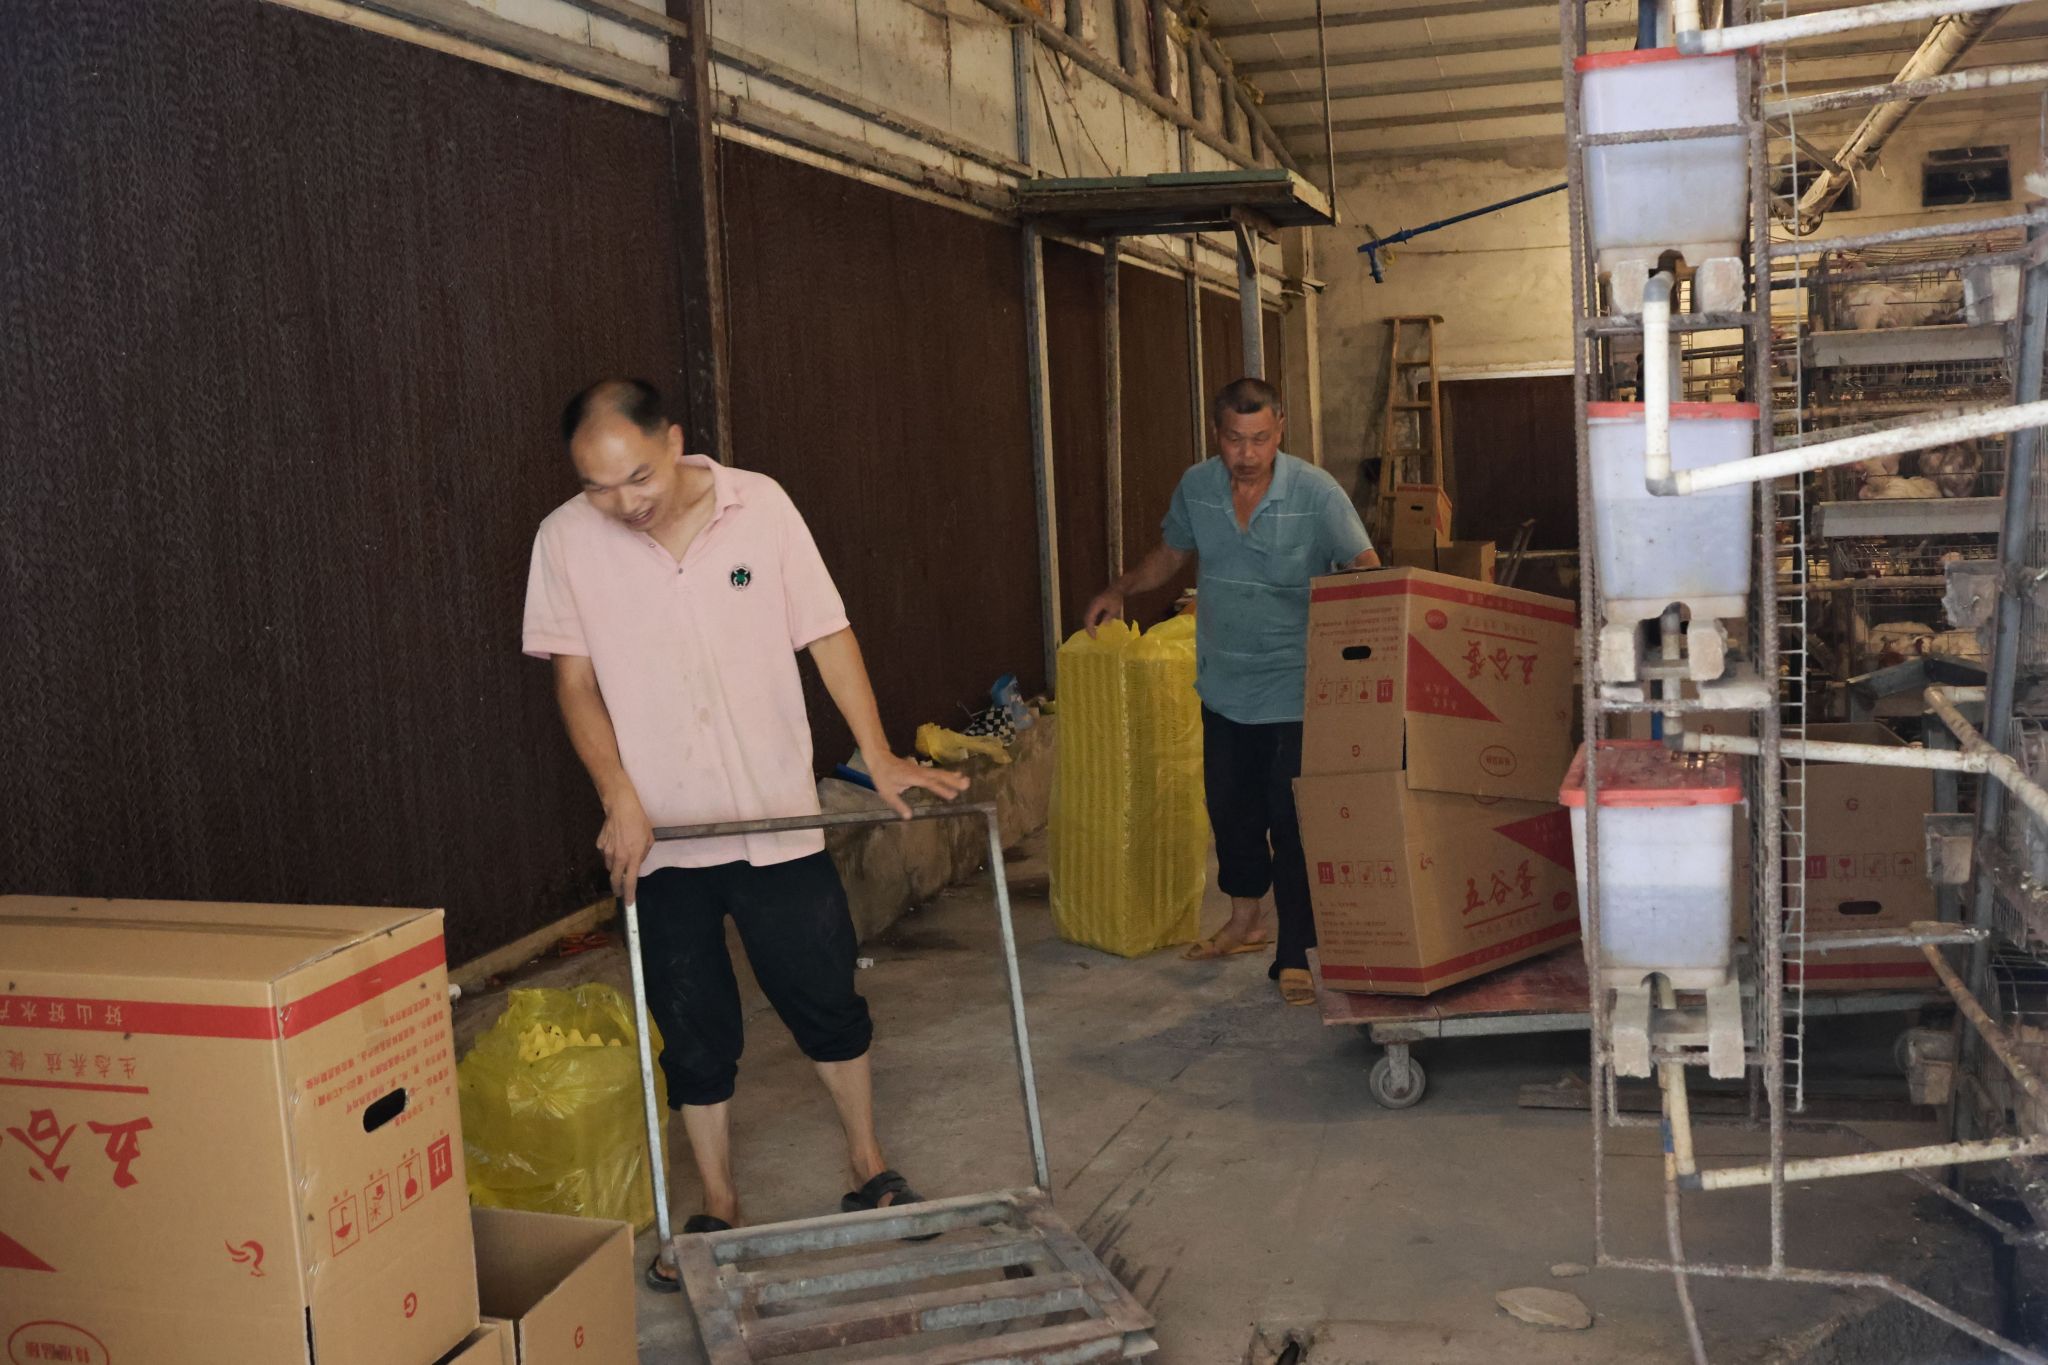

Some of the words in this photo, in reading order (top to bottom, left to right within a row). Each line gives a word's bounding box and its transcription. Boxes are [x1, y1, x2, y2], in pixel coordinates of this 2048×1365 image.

[1461, 639, 1538, 685] 五谷蛋
[1351, 744, 1361, 758] G
[1340, 806, 1350, 819] G
[1846, 798, 1859, 811] G
[1462, 859, 1537, 915] 五谷蛋
[44, 1052, 137, 1079] 生态养殖
[0, 1108, 153, 1189] 五谷
[404, 1292, 417, 1318] G
[574, 1325, 584, 1349] G
